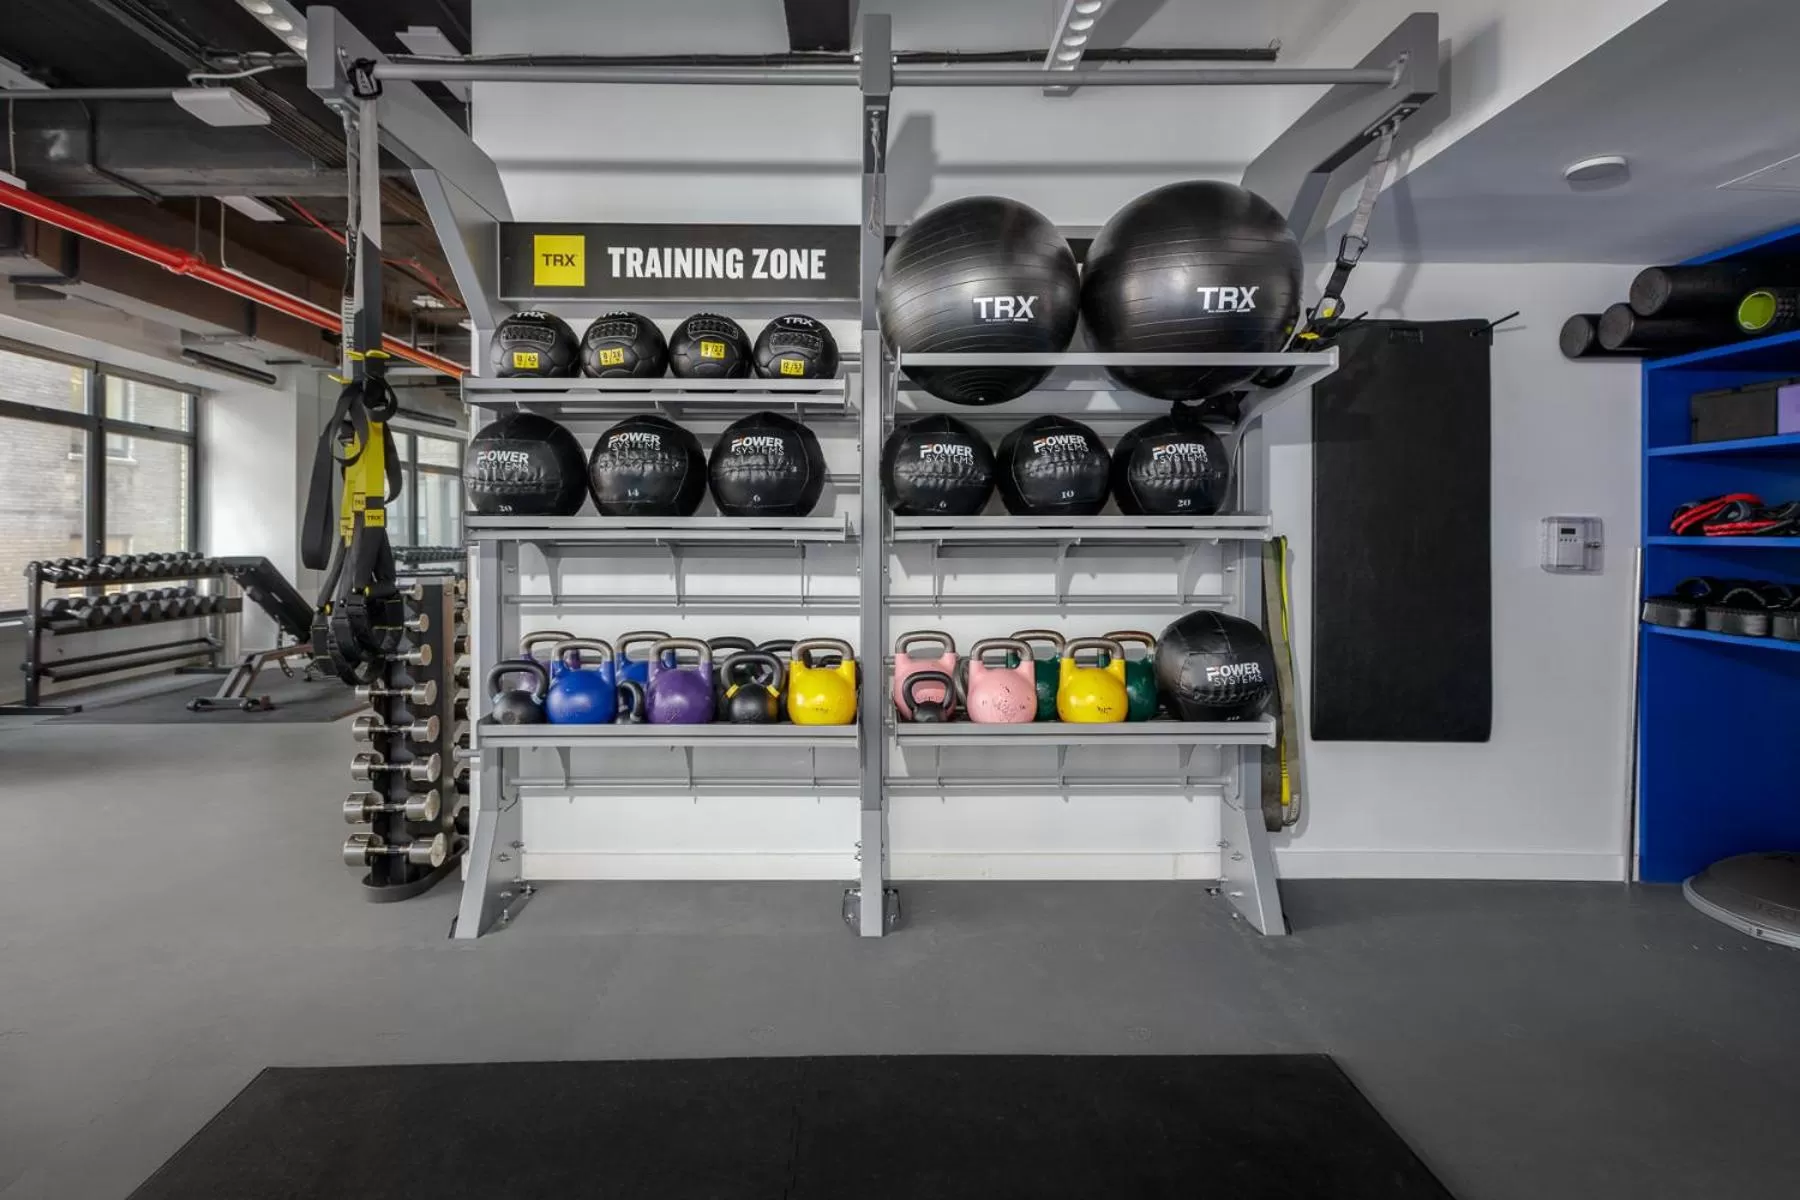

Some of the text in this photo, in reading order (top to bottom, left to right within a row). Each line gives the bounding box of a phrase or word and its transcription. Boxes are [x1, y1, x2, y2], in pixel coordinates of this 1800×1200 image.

[542, 253, 576, 267] TRX
[608, 247, 826, 280] TRAINING ZONE
[1197, 286, 1258, 310] TRX
[973, 295, 1037, 319] TRX
[608, 432, 661, 448] POWER
[612, 440, 661, 451] SYSTEMS
[731, 433, 784, 452] POWER
[1033, 435, 1087, 454] POWER
[476, 449, 529, 465] POWER
[735, 445, 785, 456] SYSTEMS
[919, 442, 973, 459] POWER
[1040, 443, 1089, 457] SYSTEMS
[1152, 443, 1207, 460] POWER
[479, 460, 529, 472] SYSTEMS
[926, 453, 974, 465] SYSTEMS
[1160, 453, 1209, 464] SYSTEMS
[1206, 661, 1262, 682] POWER
[1213, 673, 1264, 687] SYSTEMS
